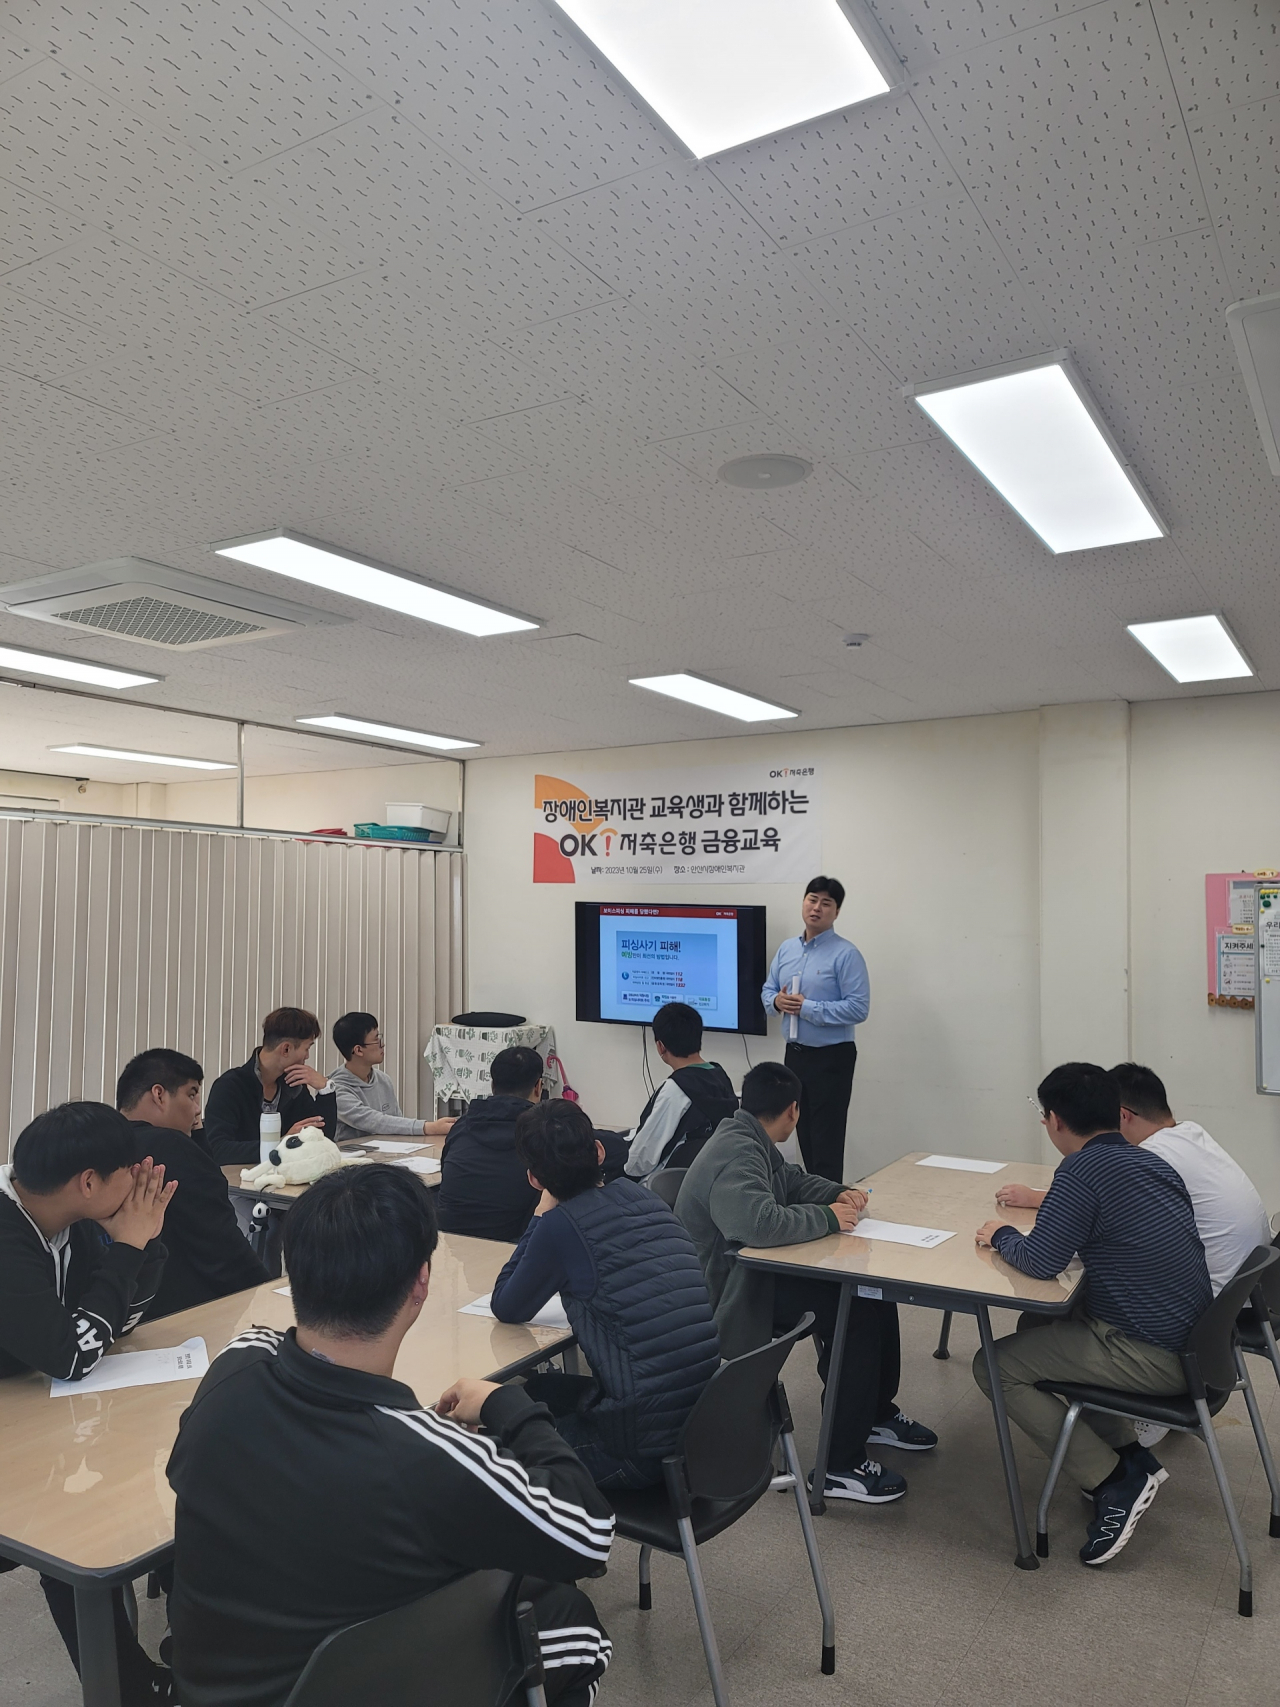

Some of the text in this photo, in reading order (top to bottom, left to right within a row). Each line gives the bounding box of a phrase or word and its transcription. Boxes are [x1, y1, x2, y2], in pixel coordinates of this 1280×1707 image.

[543, 790, 809, 823] 장애인복지관 교육생과 함께하는
[620, 831, 696, 856] 저축은행
[701, 827, 781, 854] 금융교육
[605, 866, 625, 875] 2023년
[626, 866, 639, 875] 10월
[639, 865, 663, 875] 25일(수)
[621, 939, 682, 953] 피싱사기 피해!
[1224, 942, 1254, 950] 지켜주세
